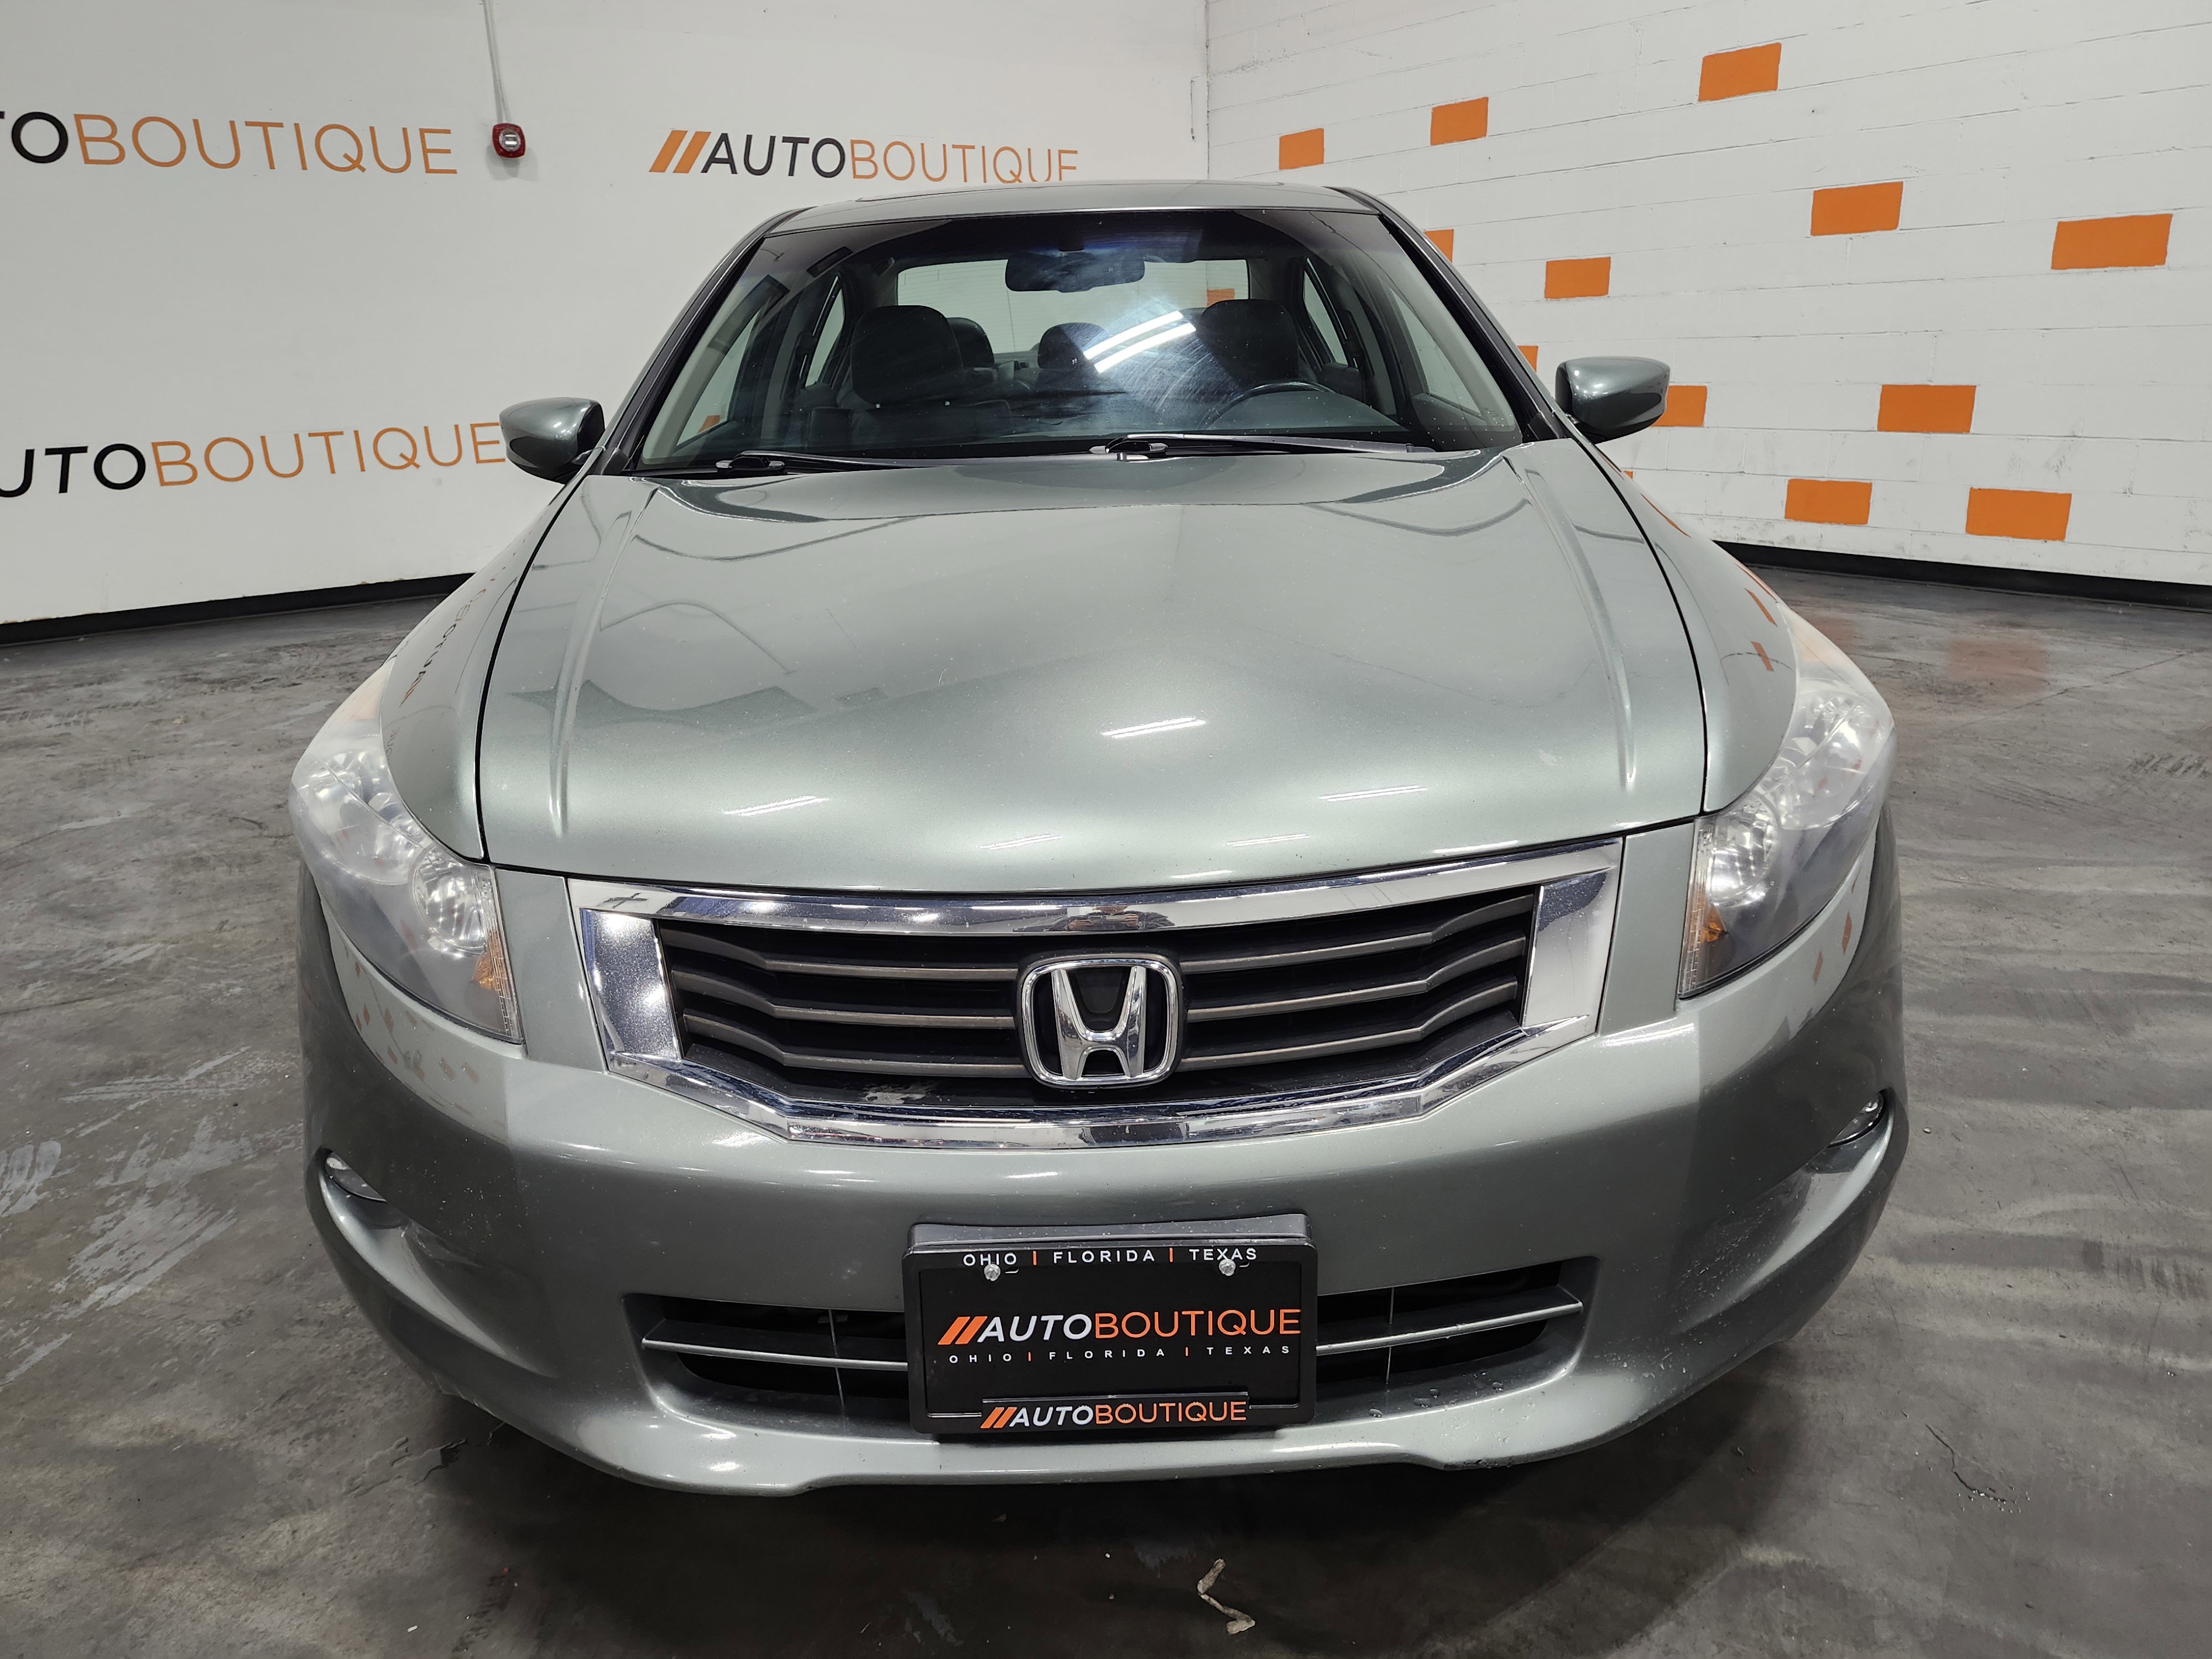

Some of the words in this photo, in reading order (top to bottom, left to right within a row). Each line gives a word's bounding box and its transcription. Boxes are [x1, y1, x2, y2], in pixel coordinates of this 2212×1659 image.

[0, 111, 457, 174] OBOUTIQUE
[700, 132, 1078, 184] AUTOBOUTIQUE
[963, 1252, 1017, 1266] OHIO
[1053, 1250, 1155, 1264] FLORIDA
[1188, 1248, 1256, 1261] TEXAS
[977, 1309, 1301, 1343] AUTOBOUTIQUE
[949, 1353, 1012, 1363] OHIO
[1049, 1348, 1165, 1360] FLORIDA
[1206, 1345, 1290, 1355] TEXAS
[1009, 1401, 1246, 1428] AUTOBOUTIQUE
